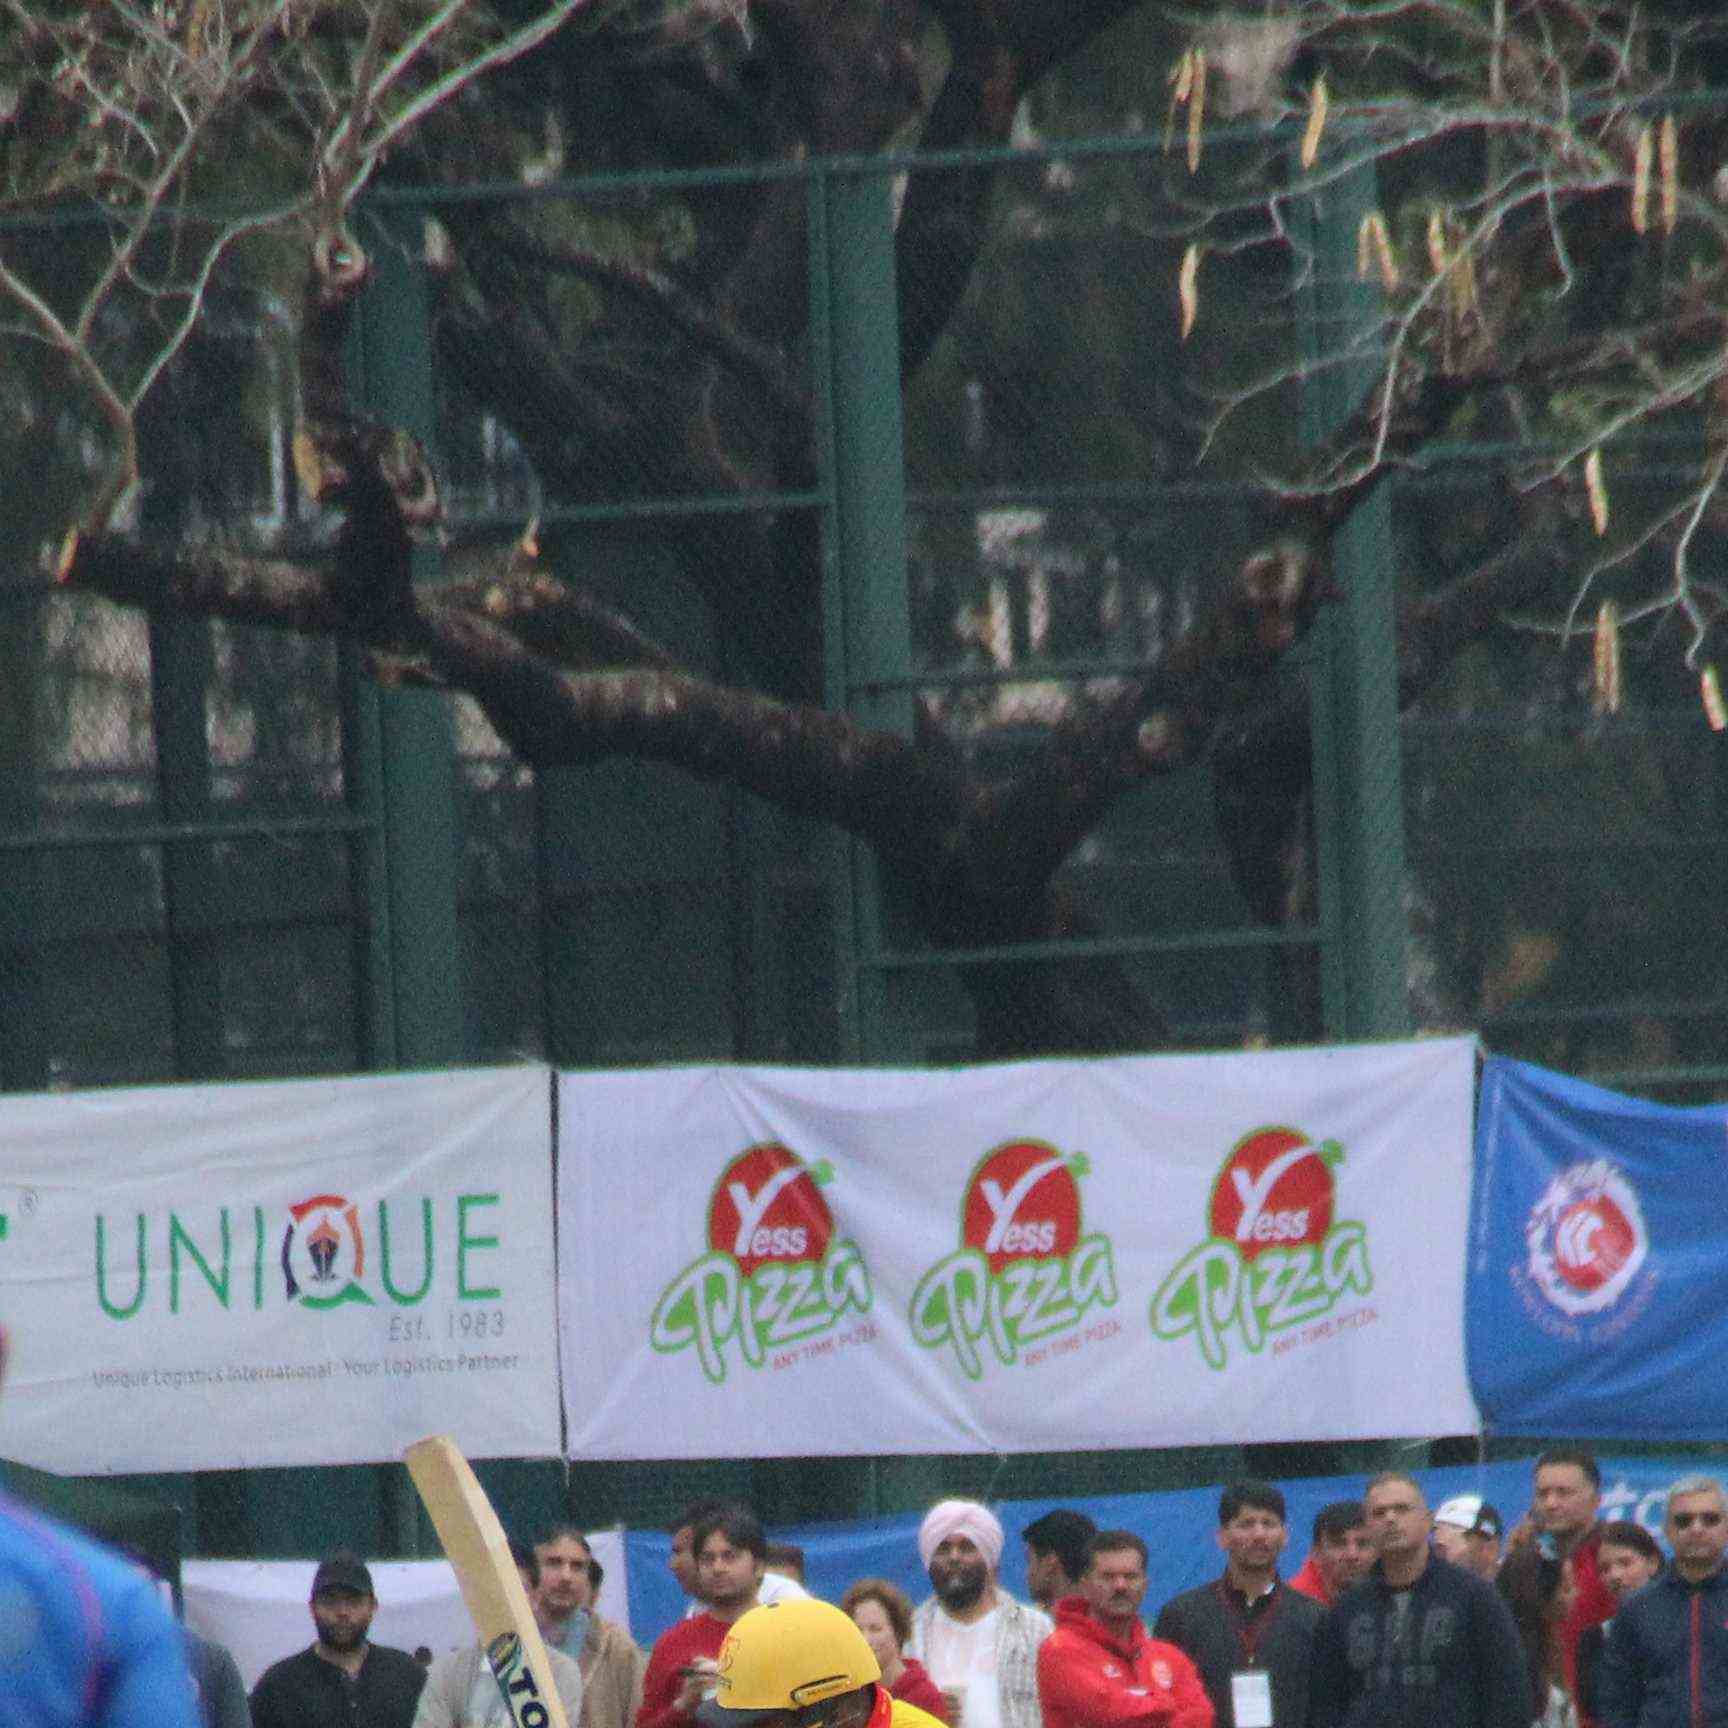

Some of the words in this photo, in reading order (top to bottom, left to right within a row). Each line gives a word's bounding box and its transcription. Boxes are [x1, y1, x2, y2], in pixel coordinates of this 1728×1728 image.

[95, 1194, 501, 1321] UNIQUE
[389, 1315, 432, 1341] Est.
[447, 1309, 505, 1338] 1983
[458, 1353, 519, 1372] Partner
